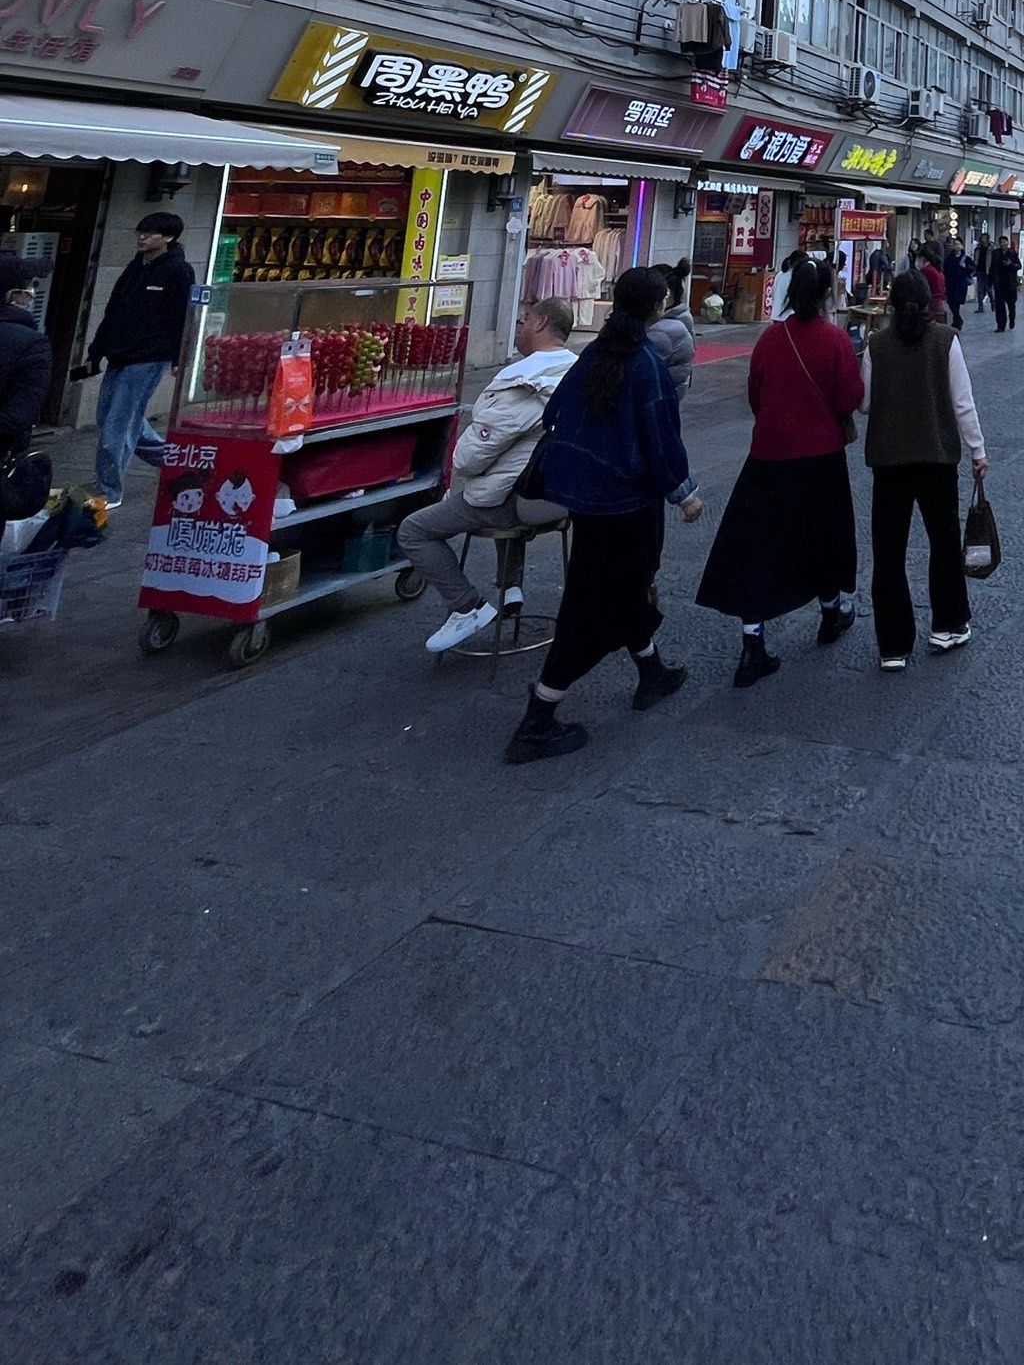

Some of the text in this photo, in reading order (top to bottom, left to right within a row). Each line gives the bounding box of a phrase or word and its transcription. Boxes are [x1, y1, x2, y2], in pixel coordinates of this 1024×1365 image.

[361, 54, 515, 109] 周黑鸭
[372, 91, 425, 114] ZHOU
[453, 105, 479, 120] YA
[623, 100, 676, 128] 罗丽丝
[162, 443, 218, 469] 老北京
[145, 553, 263, 583] 奶油草莓冰糖葫芦
